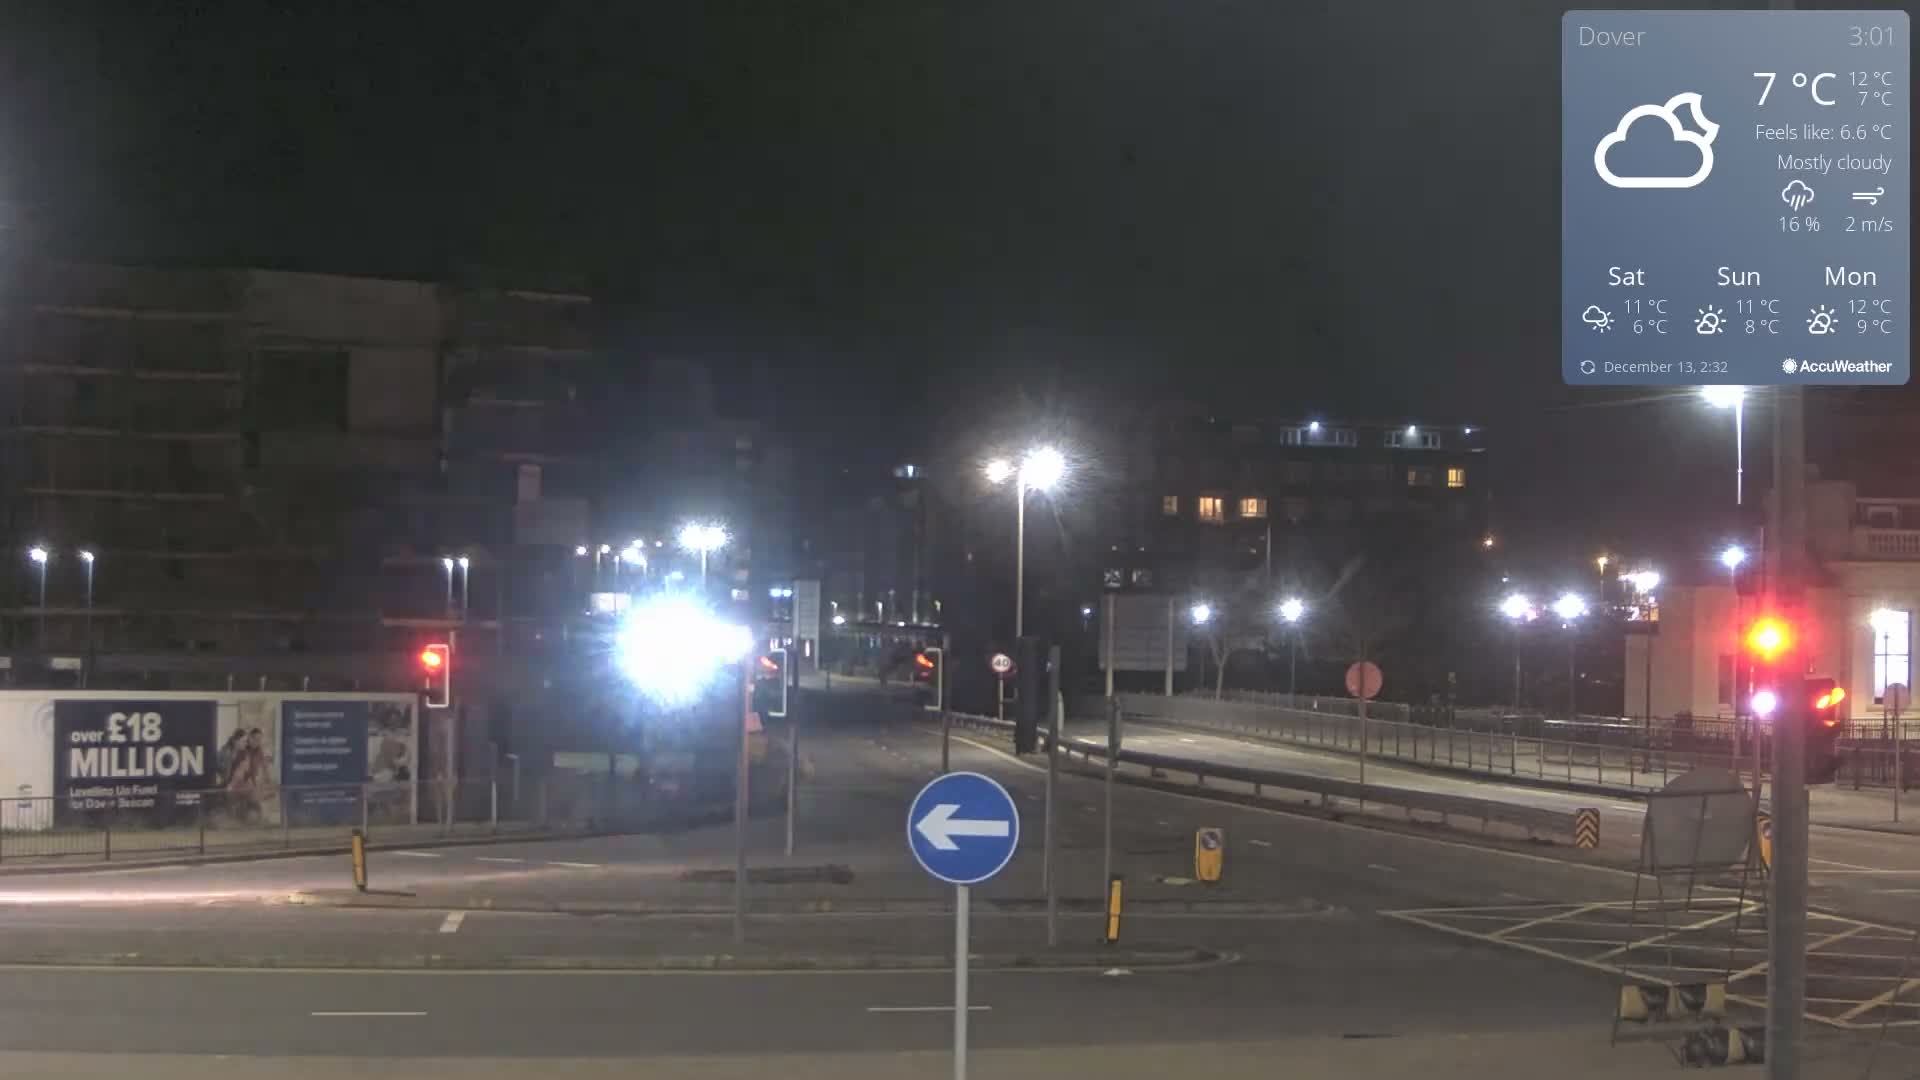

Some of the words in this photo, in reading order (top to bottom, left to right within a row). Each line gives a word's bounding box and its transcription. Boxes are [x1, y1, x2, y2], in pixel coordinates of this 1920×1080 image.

[71, 731, 104, 742] over
[109, 712, 162, 742] £18
[70, 746, 204, 777] MILLION
